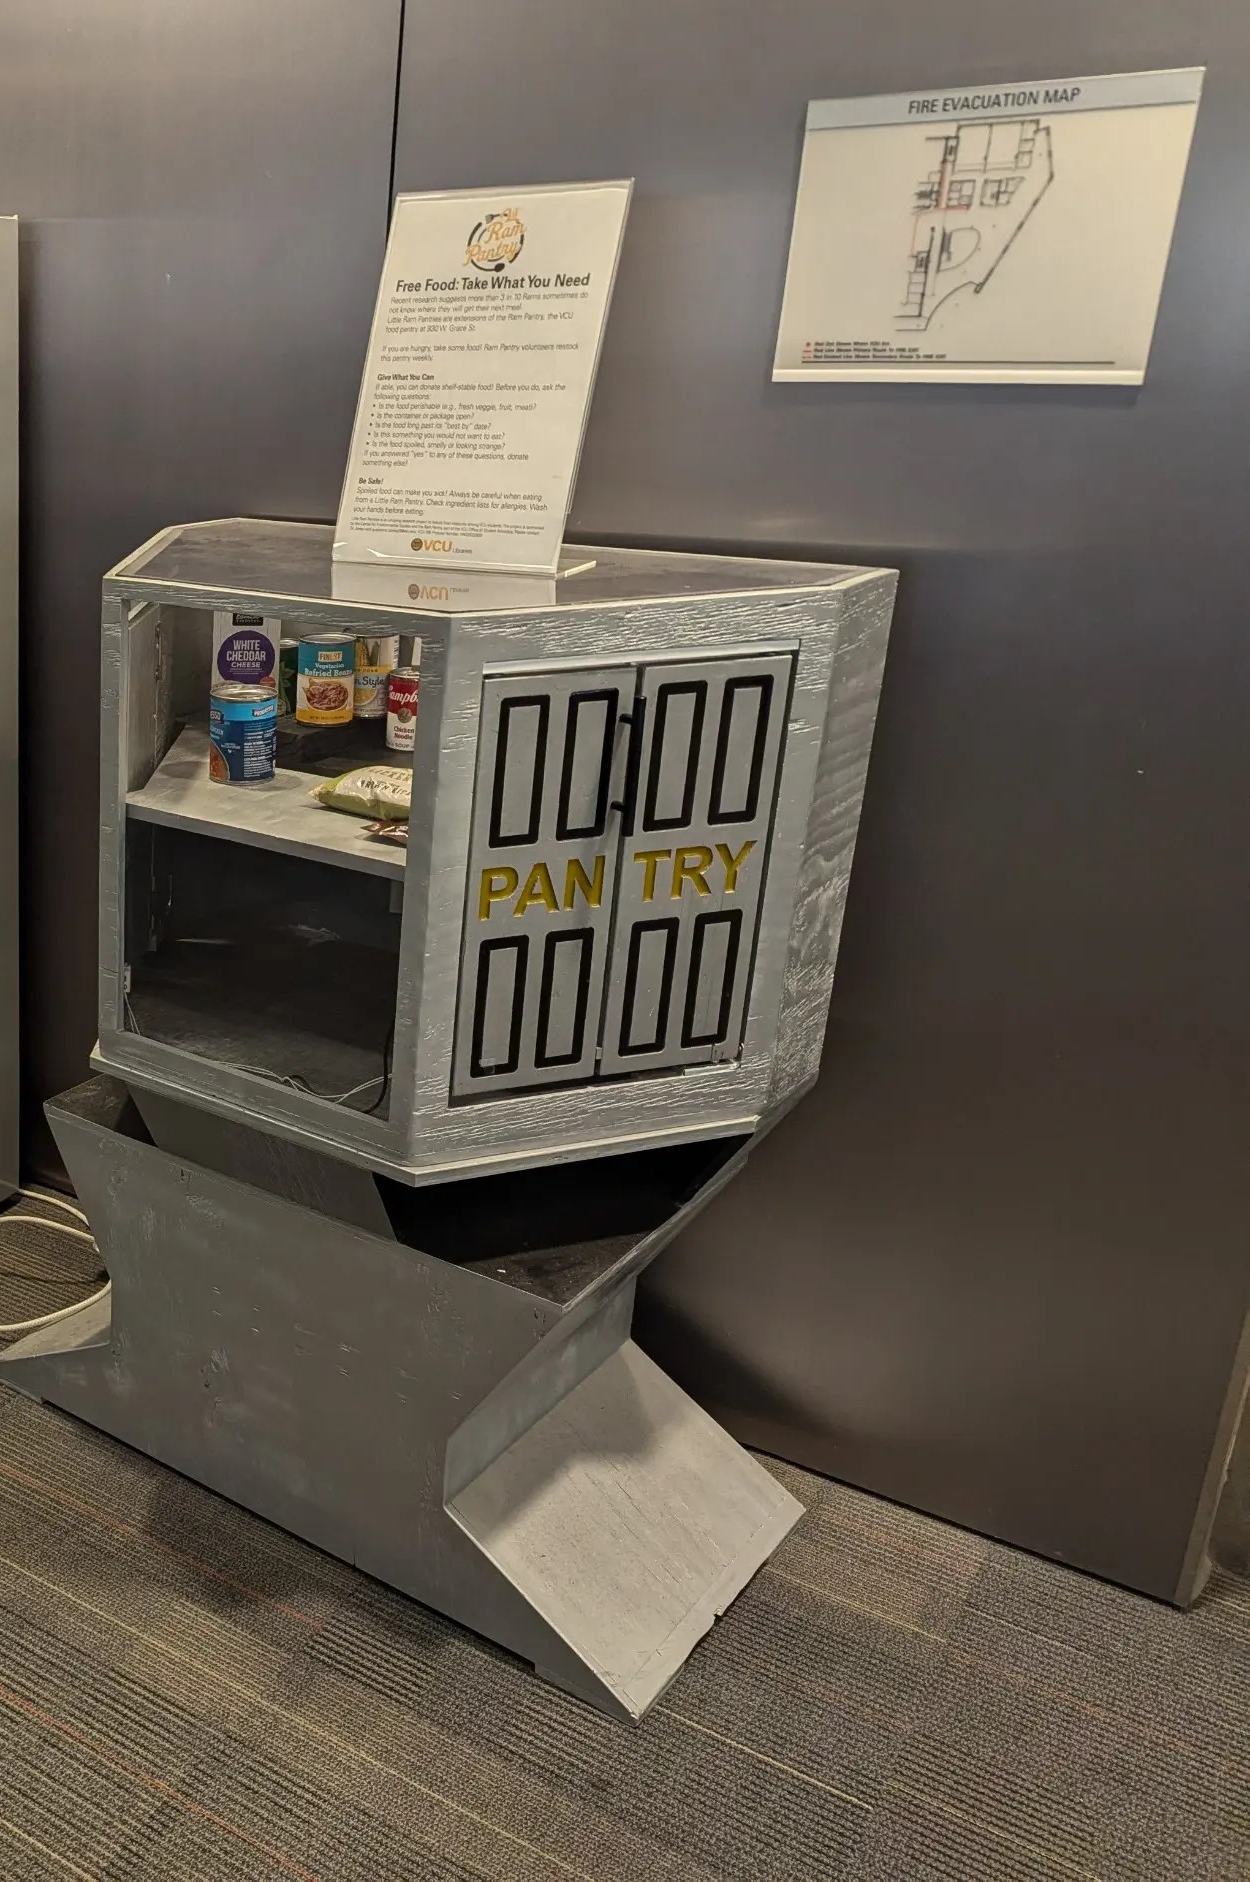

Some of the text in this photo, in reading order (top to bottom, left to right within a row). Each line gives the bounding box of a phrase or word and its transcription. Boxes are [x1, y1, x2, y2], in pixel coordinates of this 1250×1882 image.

[908, 87, 1081, 115] FIRE EVACUATION MAP
[485, 222, 526, 244] Ram
[463, 242, 519, 266] Pantry
[395, 273, 590, 291] Free Food: Take What You Need
[423, 540, 452, 553] VCU
[233, 639, 261, 651] WHITE
[226, 650, 267, 662] CHEDDAR
[304, 668, 332, 676] Refried
[334, 669, 353, 677] Beans
[362, 676, 385, 688] Style
[393, 726, 414, 734] Chicken
[394, 732, 413, 740] Noodle
